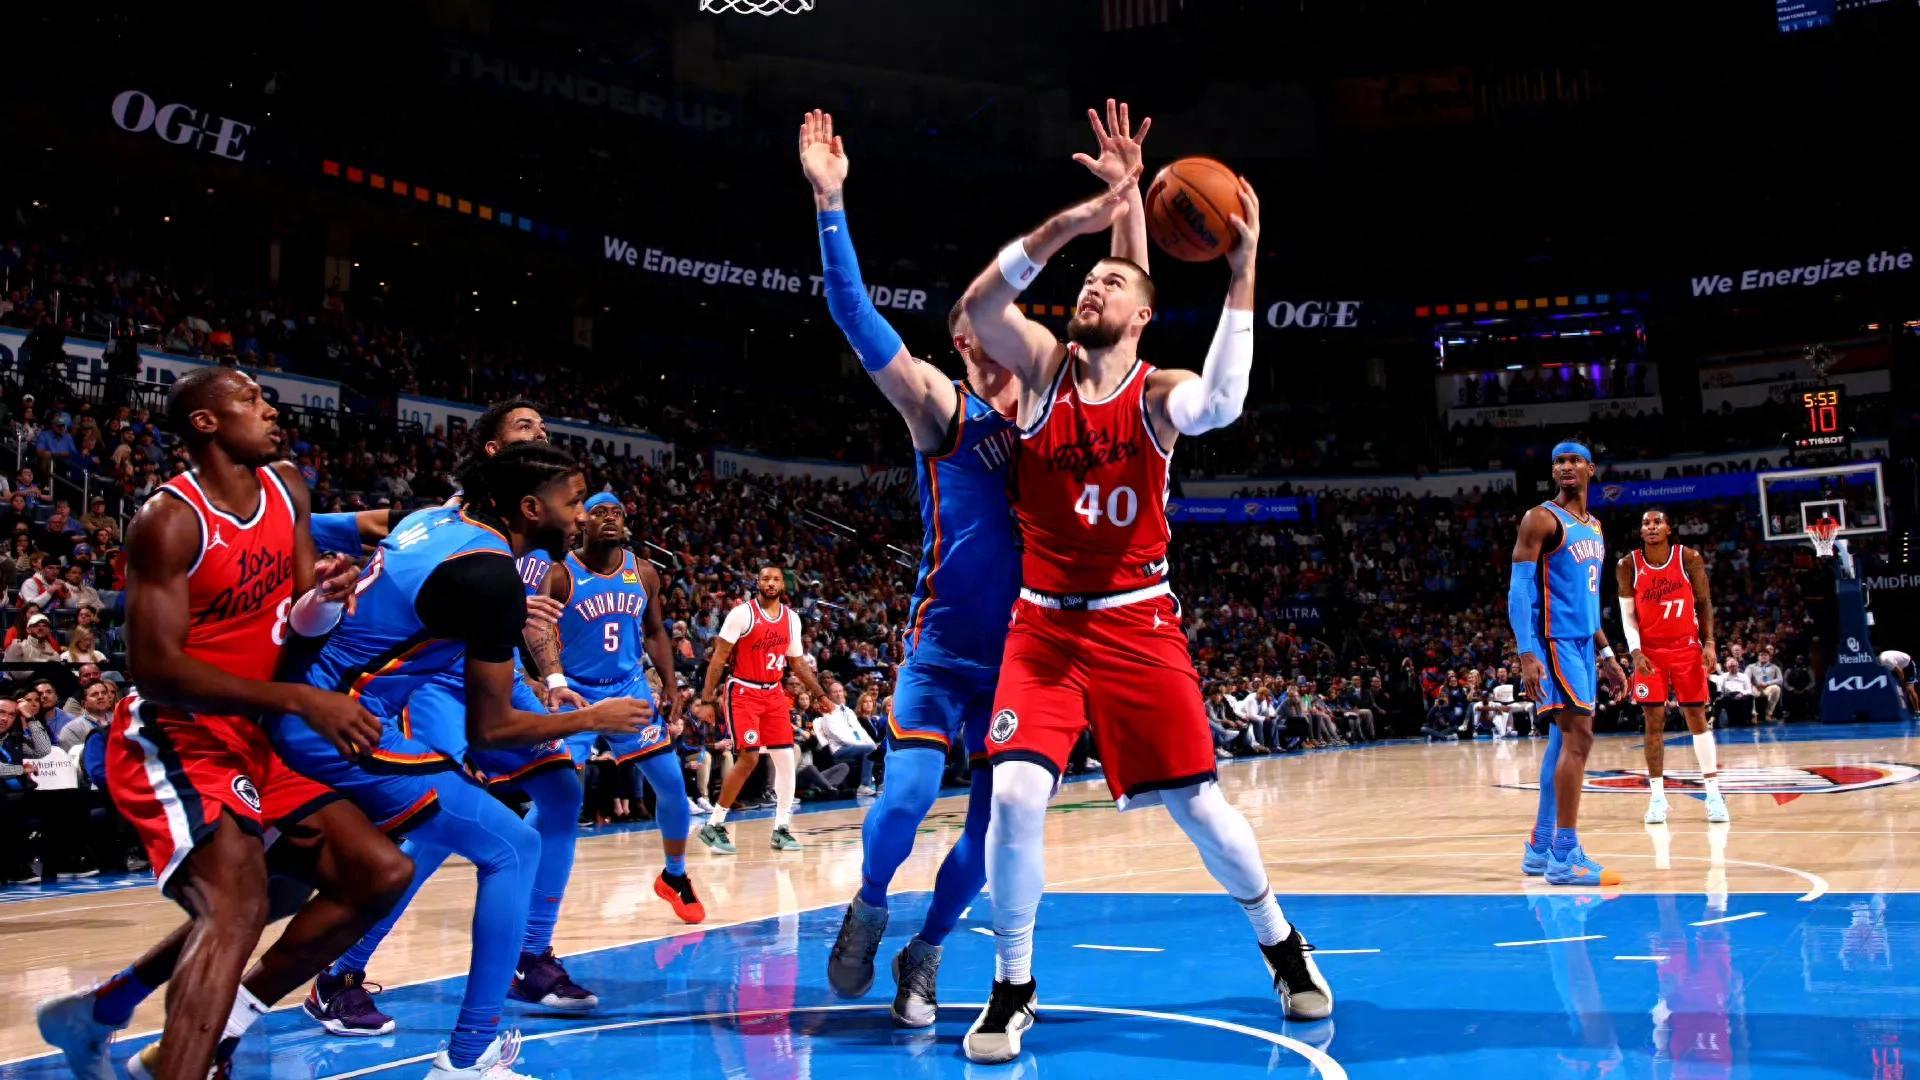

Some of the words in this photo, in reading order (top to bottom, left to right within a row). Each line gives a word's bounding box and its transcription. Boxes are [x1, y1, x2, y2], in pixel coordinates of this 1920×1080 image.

[604, 235, 638, 266] We
[643, 248, 757, 285] Energize
[762, 267, 801, 293] the
[1691, 274, 1733, 297] We
[1740, 258, 1861, 291] Energize
[1867, 250, 1913, 273] the
[1803, 391, 1839, 408] 5:53
[1811, 407, 1837, 433] 10
[1808, 436, 1844, 446] TISSOT
[1639, 484, 1696, 497] ticketmaster
[1074, 484, 1138, 528] 40
[237, 546, 275, 587] Los
[1588, 564, 1599, 592] 2
[191, 551, 291, 627] Angele
[575, 592, 644, 621] THUNDER
[1275, 607, 1321, 619] ULTRA
[1660, 600, 1685, 619] 77
[271, 596, 292, 645] 8
[604, 622, 619, 651] 5
[1847, 637, 1860, 652] OU
[766, 653, 787, 671] 24
[1840, 652, 1872, 664] Health
